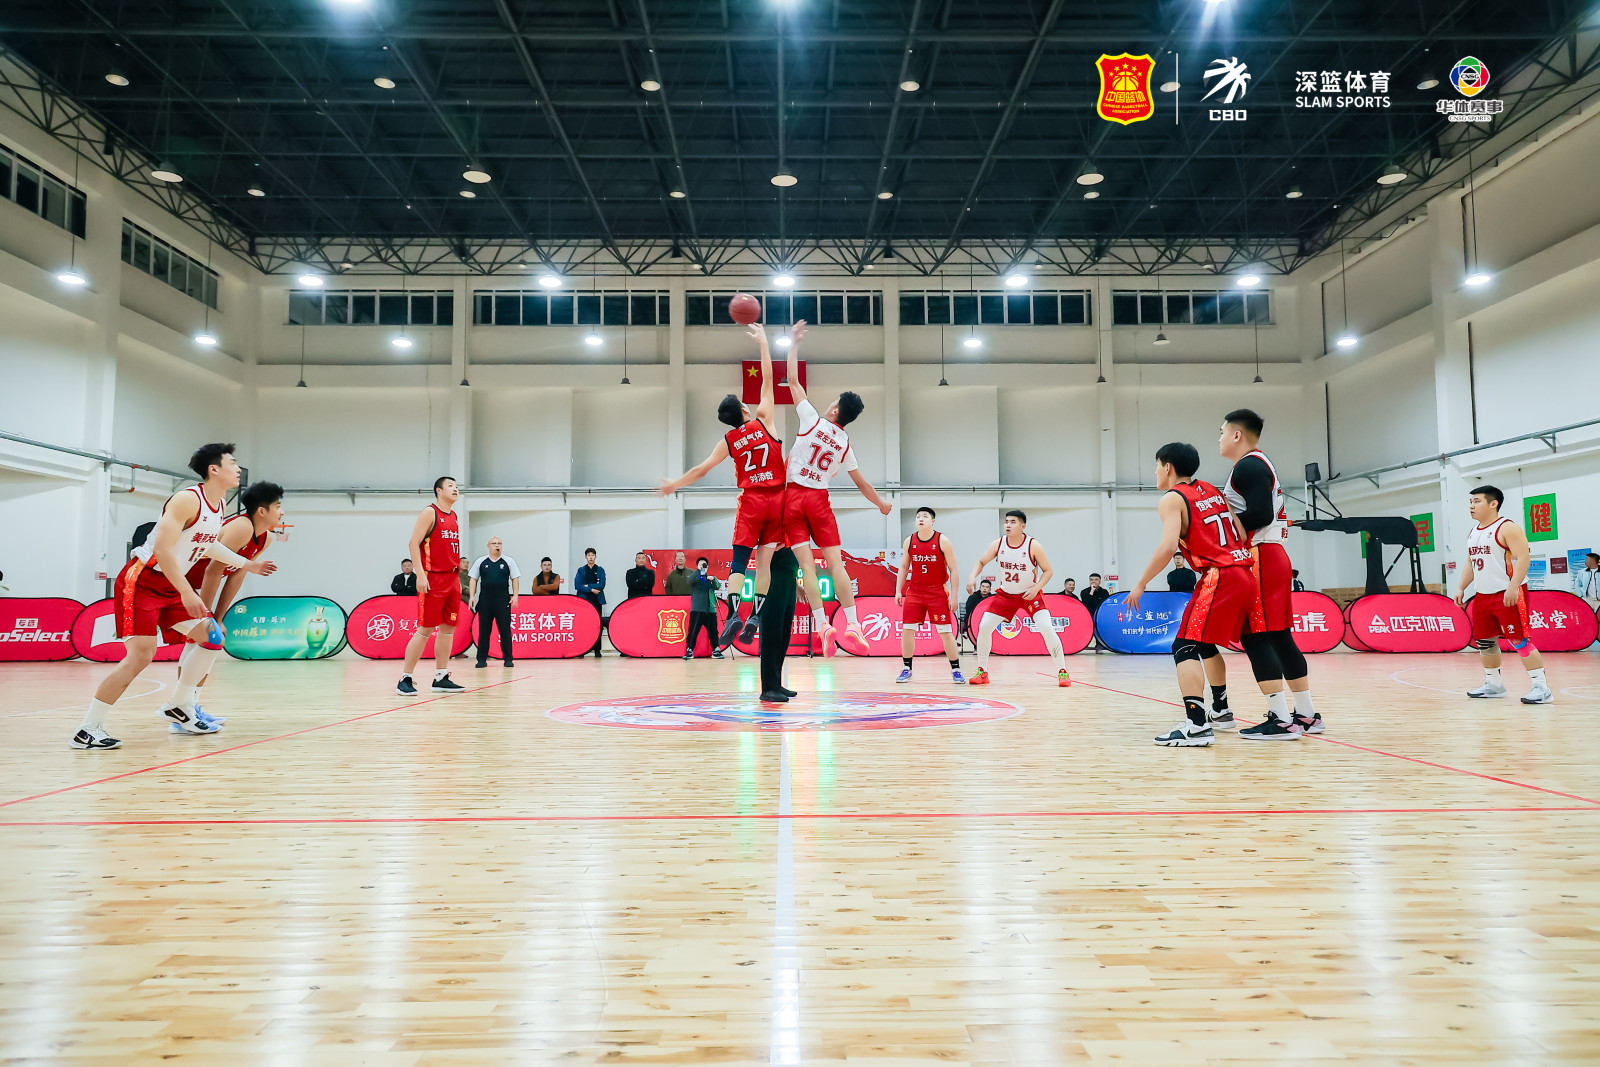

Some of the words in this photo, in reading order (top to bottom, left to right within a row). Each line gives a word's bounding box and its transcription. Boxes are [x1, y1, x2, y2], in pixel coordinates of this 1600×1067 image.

[740, 443, 769, 472] 27
[808, 442, 833, 471] 16
[1530, 502, 1552, 533] 健
[191, 532, 218, 543] 美丽大
[1203, 511, 1239, 547] 77
[921, 564, 928, 574] 5
[1005, 572, 1020, 583] 24
[741, 578, 754, 599] 0
[818, 578, 830, 598] 0
[1368, 625, 1391, 634] PEAK
[1389, 616, 1455, 632] 匹克体育
[530, 632, 575, 642] SPORTS
